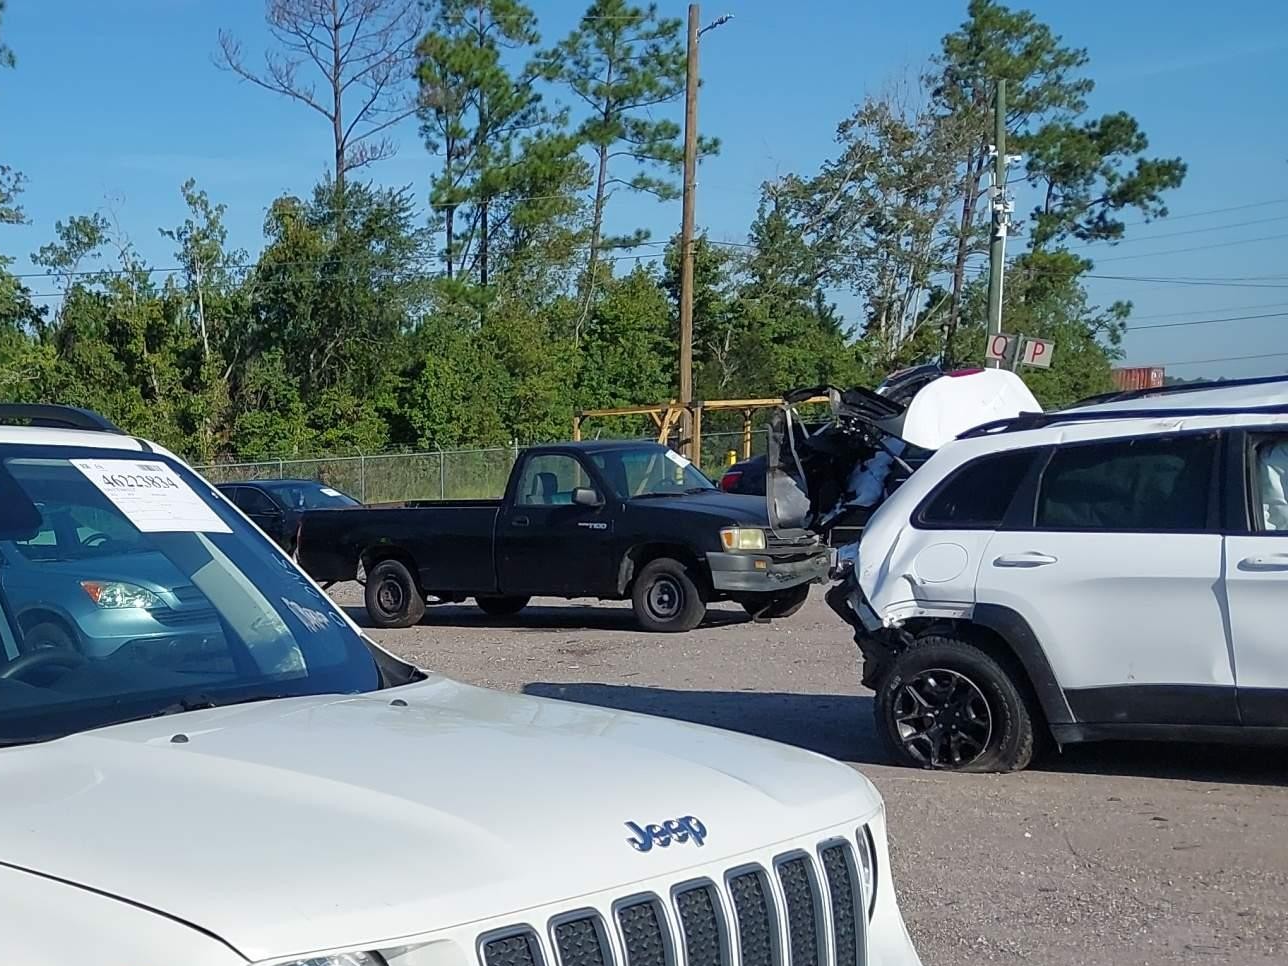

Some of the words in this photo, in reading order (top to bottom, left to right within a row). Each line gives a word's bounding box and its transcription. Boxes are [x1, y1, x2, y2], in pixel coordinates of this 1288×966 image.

[992, 335, 1007, 360] Q
[1031, 341, 1045, 364] P
[102, 474, 179, 489] 46223834
[624, 815, 707, 852] Jeep
